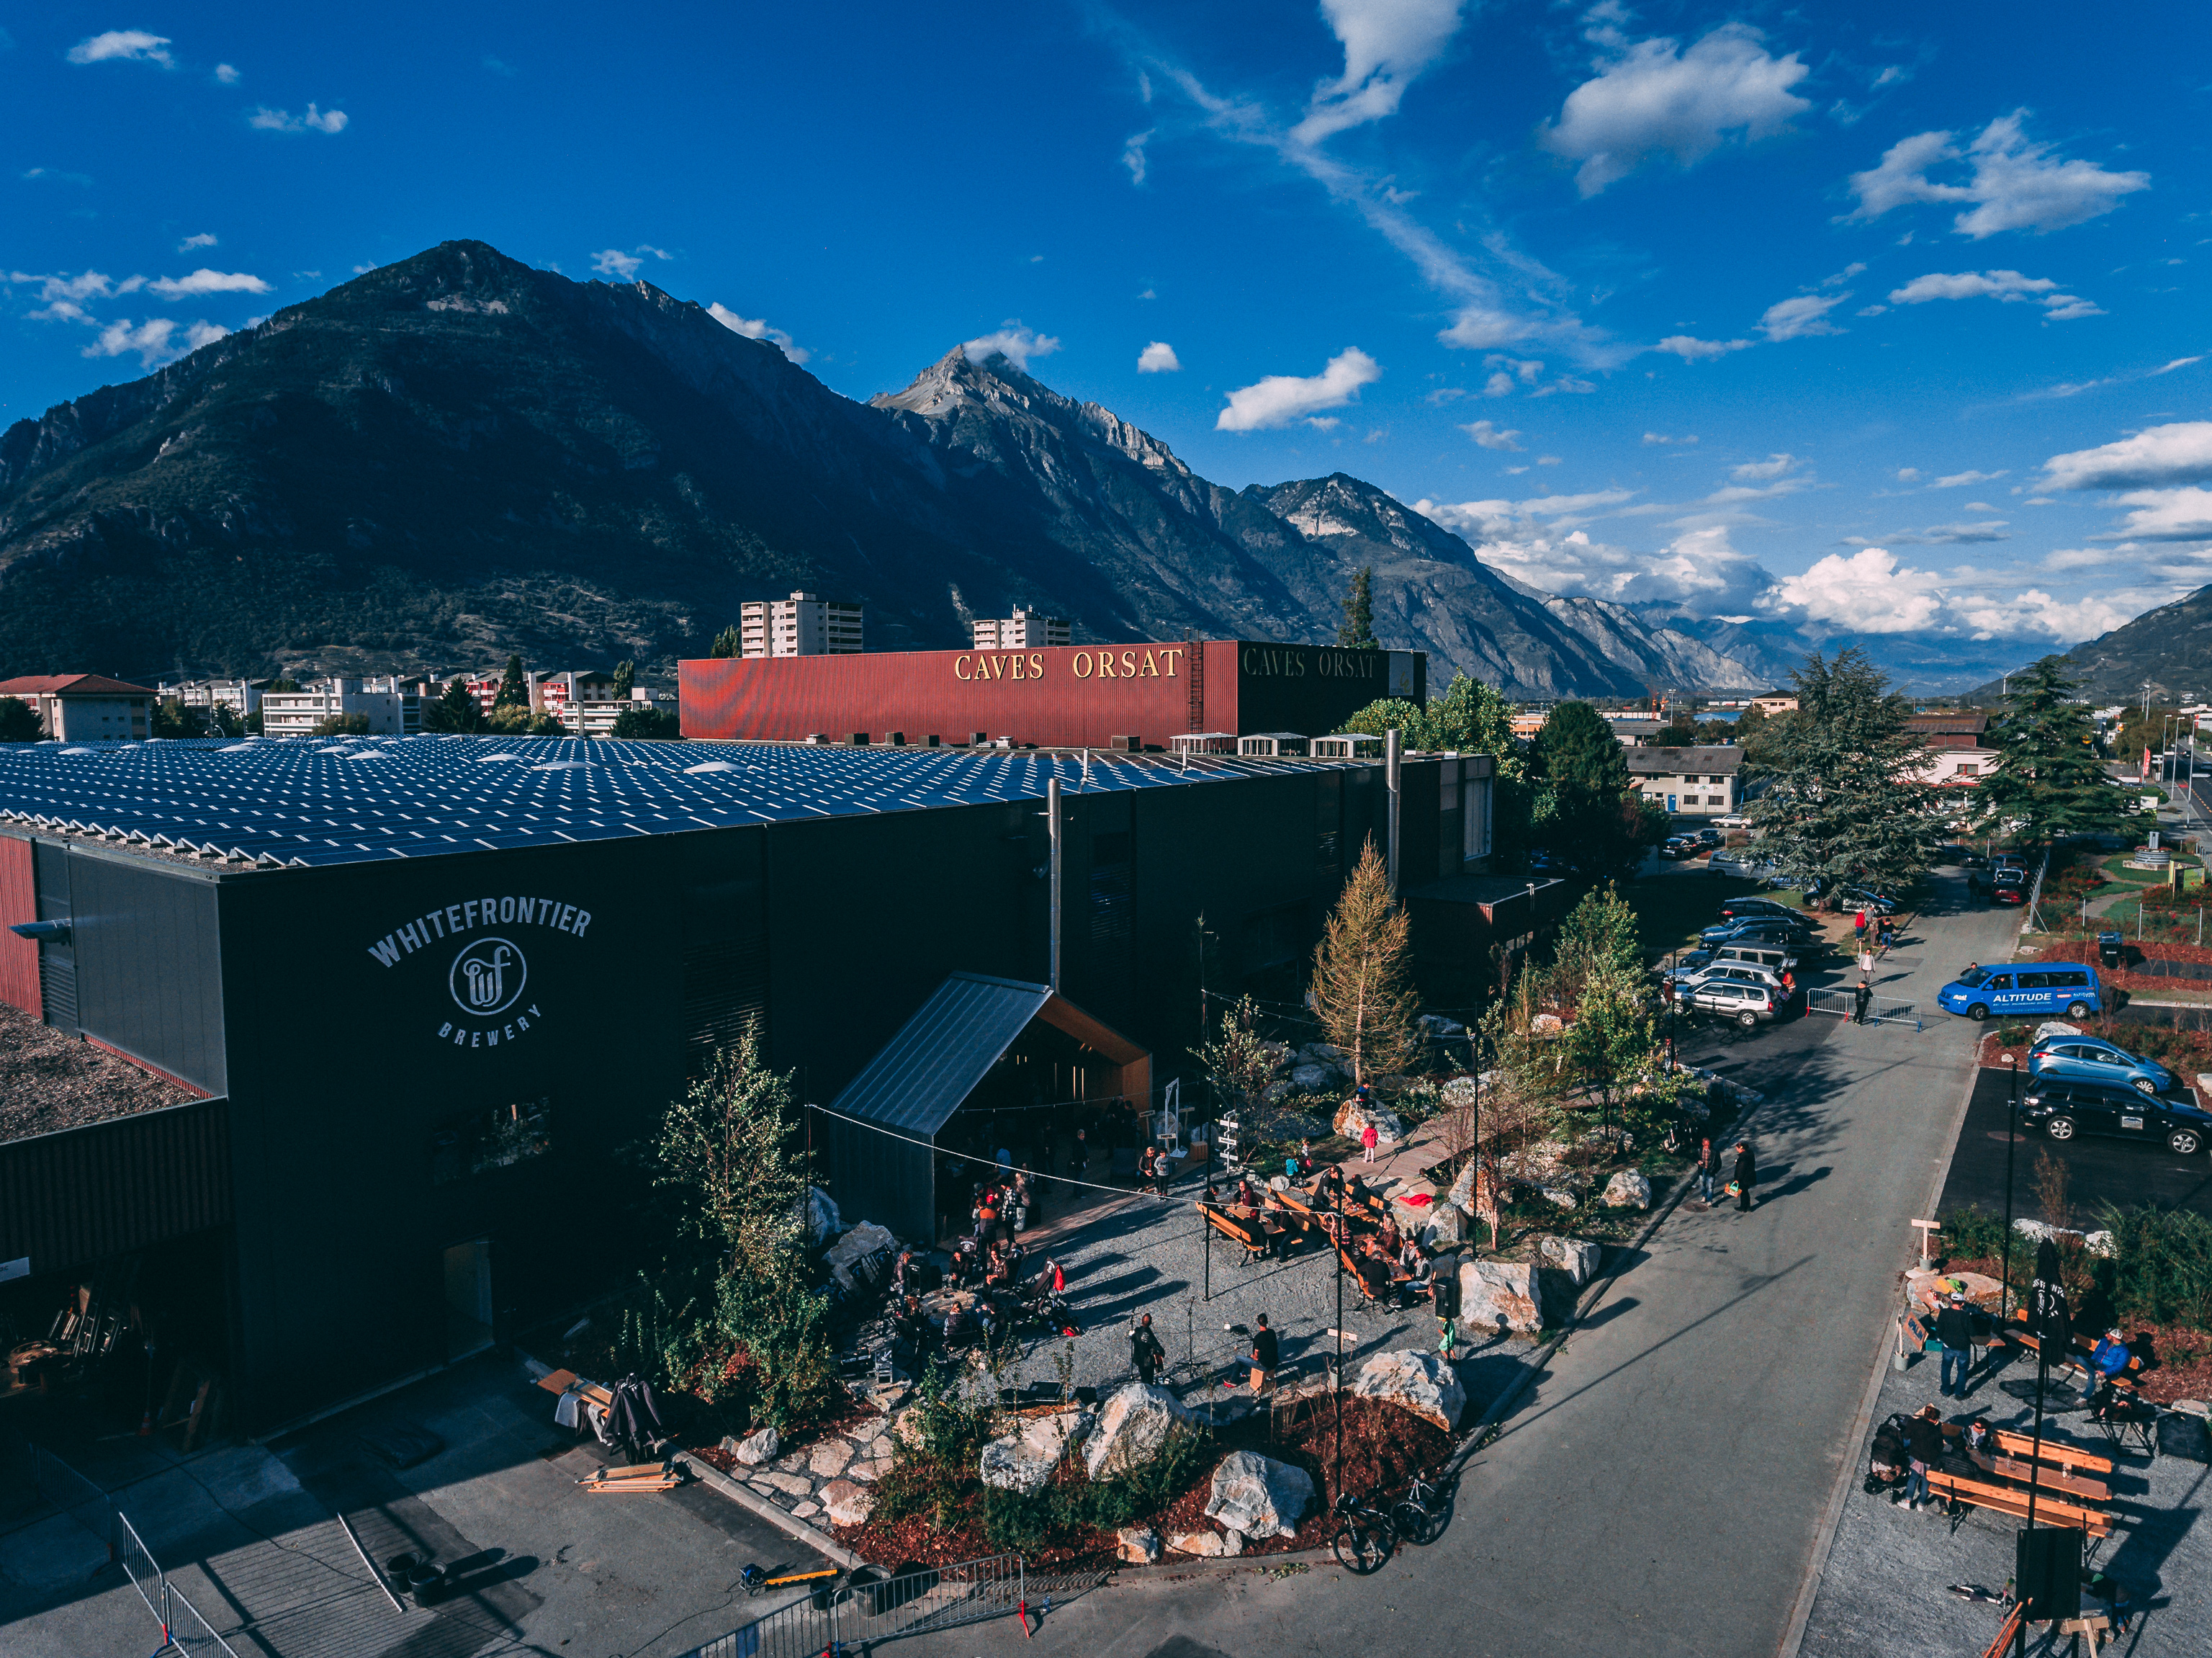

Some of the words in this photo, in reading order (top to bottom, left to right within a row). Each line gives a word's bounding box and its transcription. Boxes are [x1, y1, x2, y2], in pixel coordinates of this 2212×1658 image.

[955, 654, 1045, 681] CAVES
[1073, 649, 1185, 678] ORSAT
[1244, 648, 1305, 677] CAVES
[1318, 651, 1377, 678] ORSAT
[367, 897, 592, 968] WHITEFRONTIER
[1993, 992, 2051, 1002] ALTITUDE
[438, 1004, 541, 1048] BREWERY
